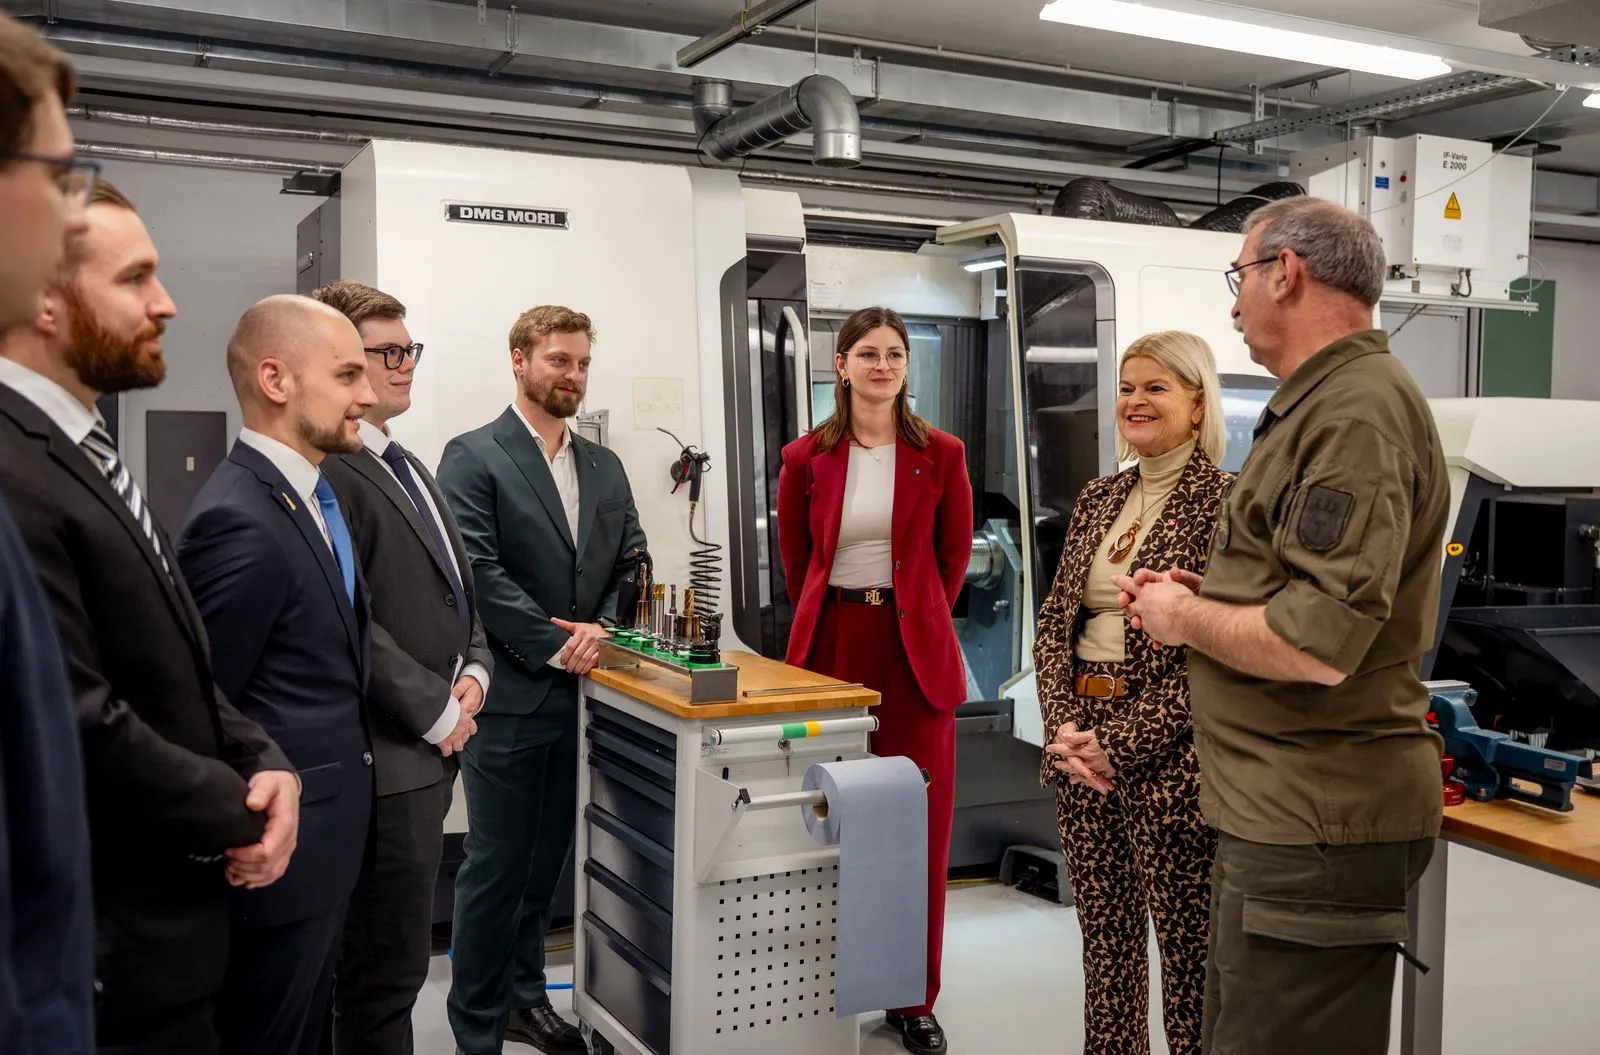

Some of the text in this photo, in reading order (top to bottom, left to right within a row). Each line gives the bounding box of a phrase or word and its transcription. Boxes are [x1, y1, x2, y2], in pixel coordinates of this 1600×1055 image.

[1443, 151, 1468, 161] IF-Vario
[1443, 160, 1467, 170] E 2000
[459, 206, 556, 225] DMG MORI
